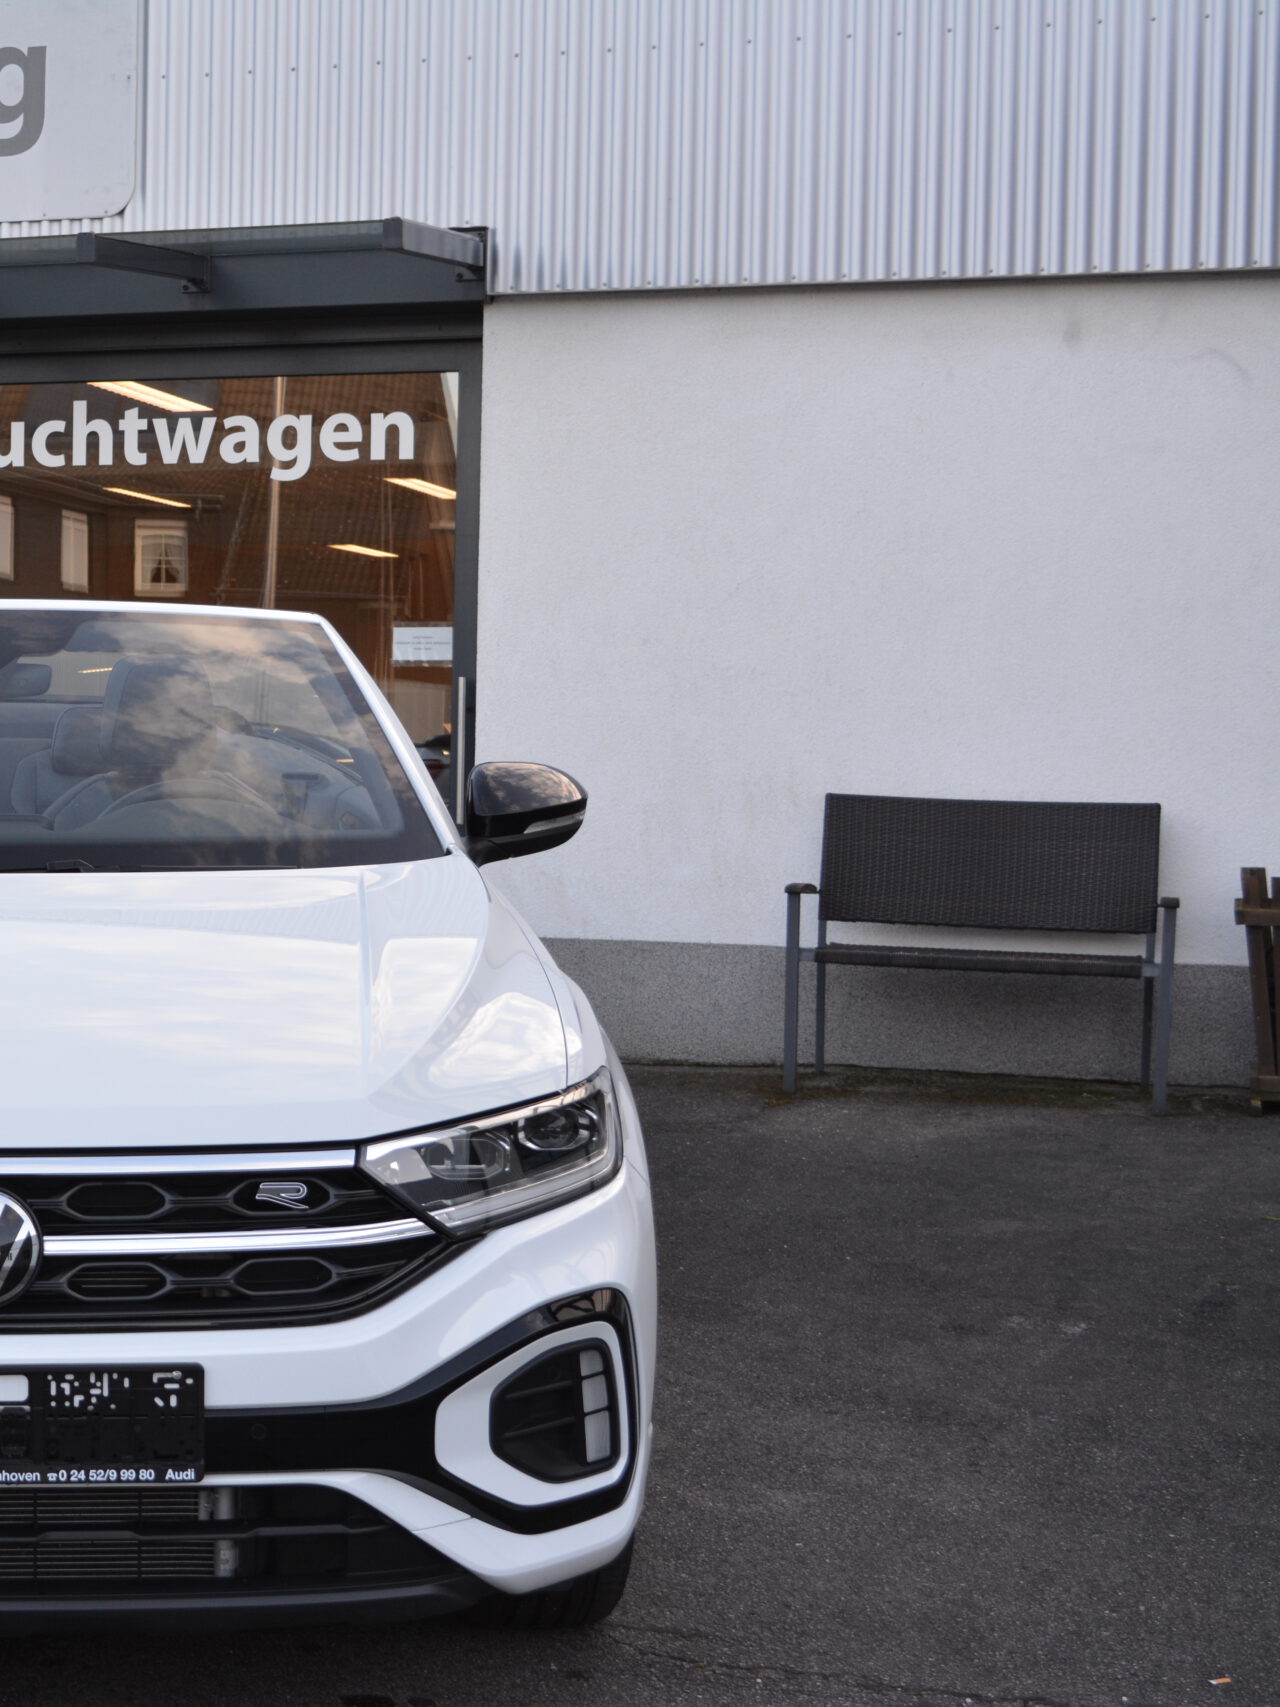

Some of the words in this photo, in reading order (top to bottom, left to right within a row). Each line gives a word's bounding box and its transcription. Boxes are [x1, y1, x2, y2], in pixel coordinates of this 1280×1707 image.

[70, 1470, 86, 1481] 24
[88, 1469, 117, 1482] 52/9
[120, 1469, 136, 1481] 99
[138, 1469, 155, 1480] 80
[165, 1468, 196, 1481] Audi
